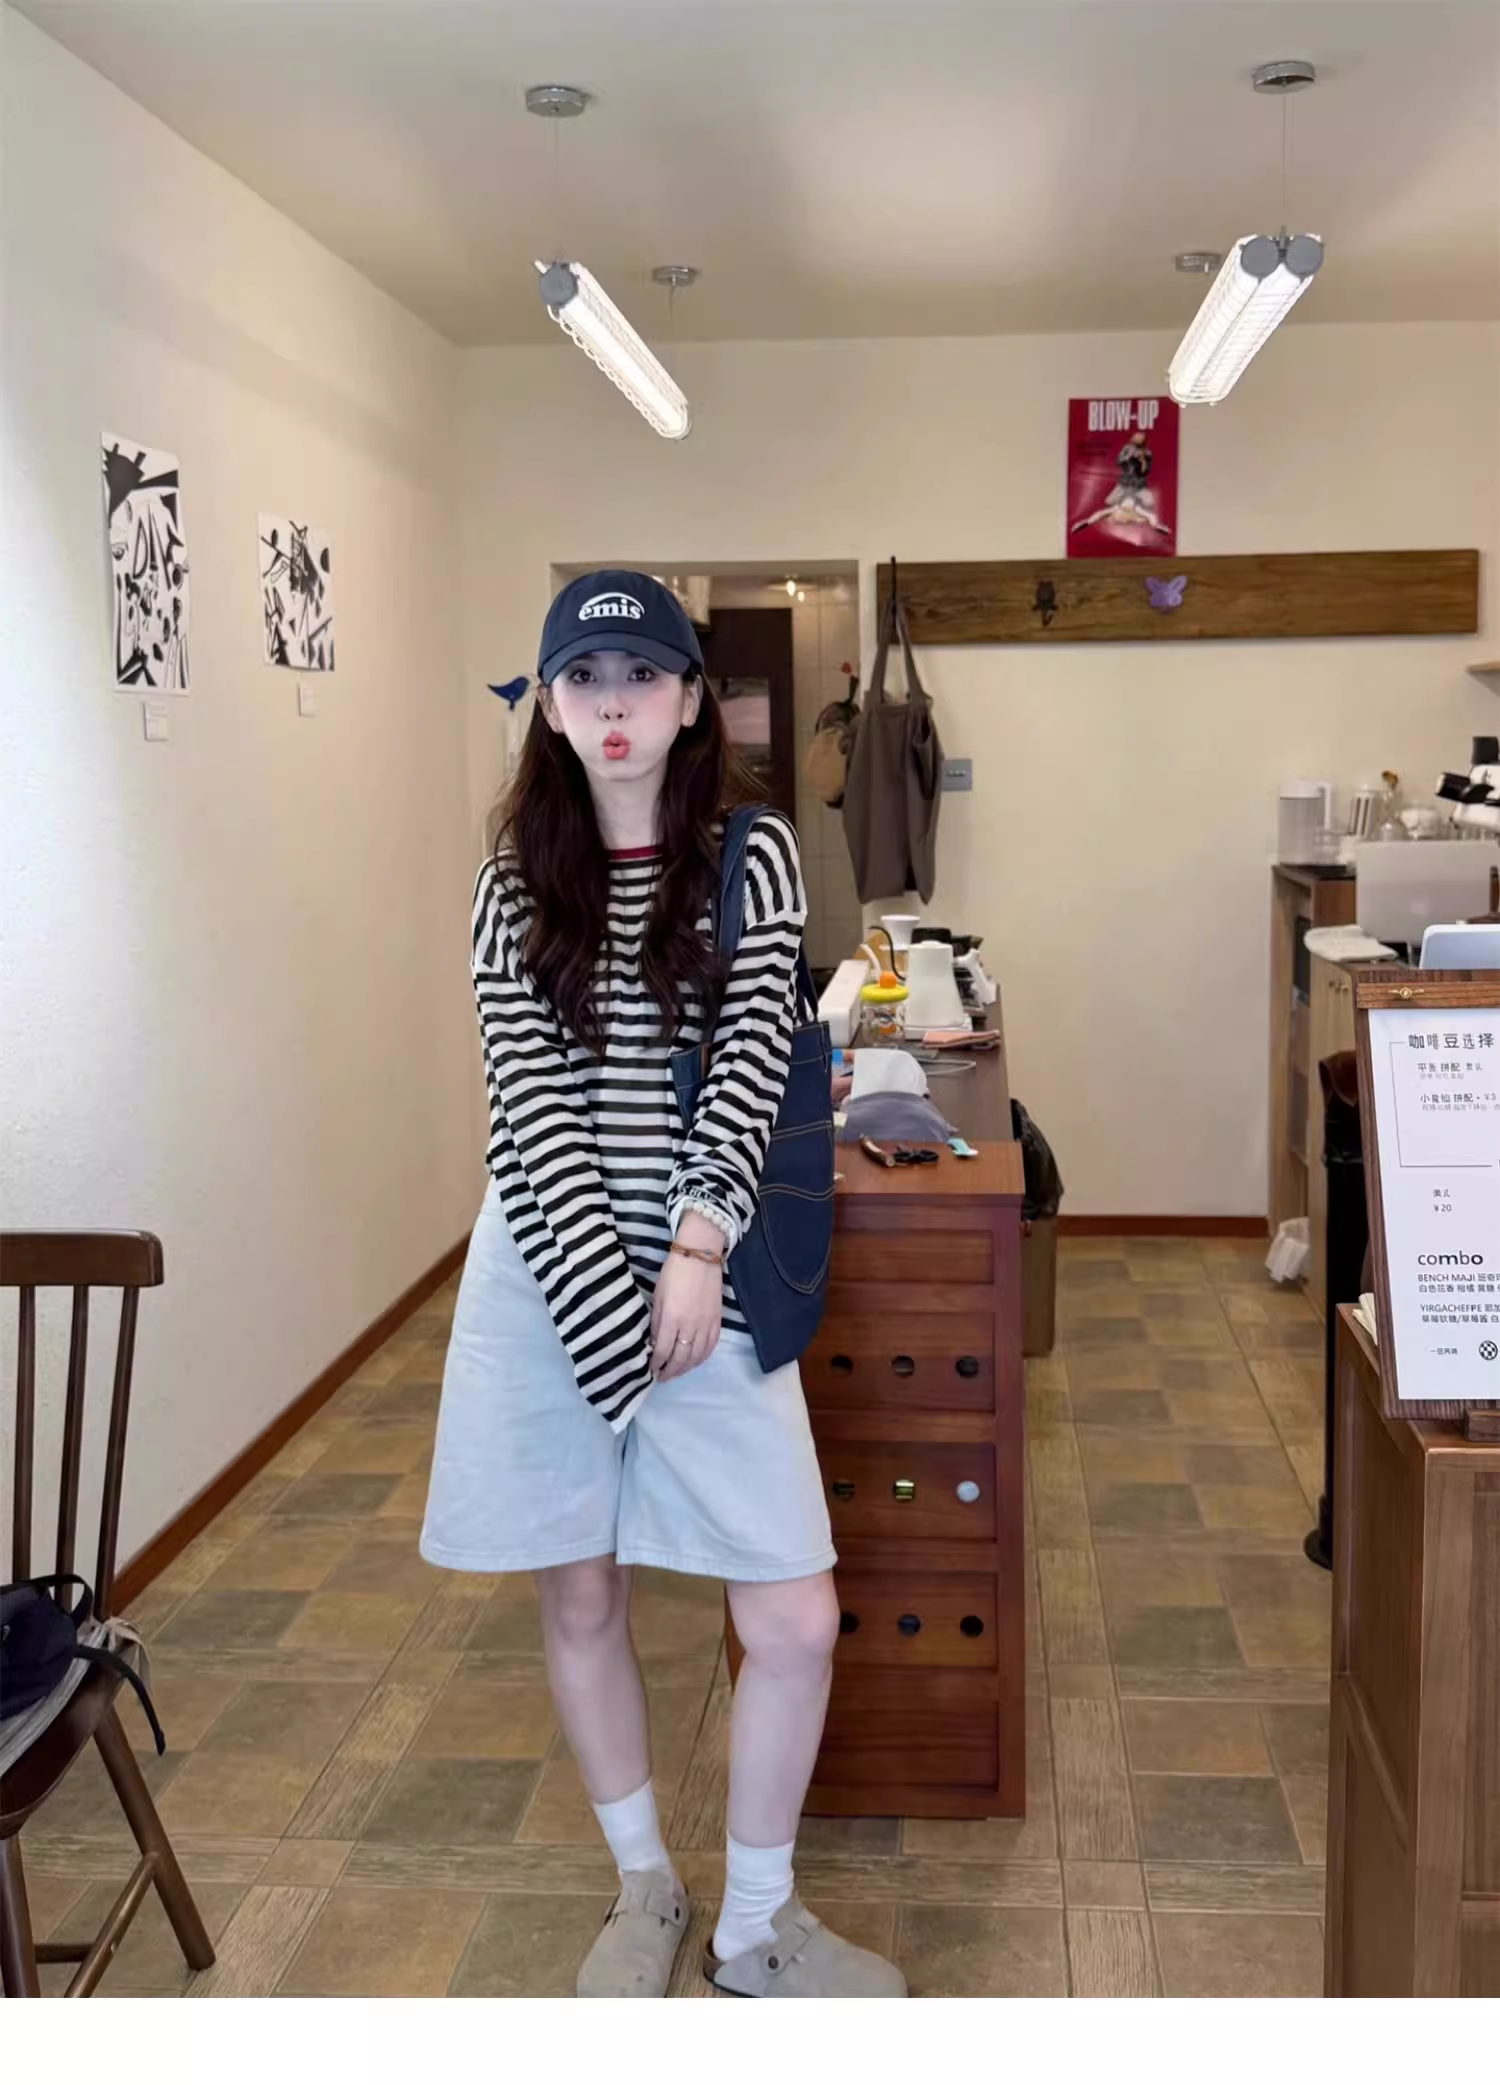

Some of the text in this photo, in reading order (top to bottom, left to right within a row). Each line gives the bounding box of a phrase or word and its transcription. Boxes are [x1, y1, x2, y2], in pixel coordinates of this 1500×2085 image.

[1088, 400, 1159, 431] BLOW-UP
[578, 598, 641, 621] emis
[1408, 1033, 1494, 1049] 咖啡豆选择
[1418, 1250, 1484, 1266] combo
[1418, 1274, 1449, 1282] BENCH
[1451, 1274, 1475, 1282] MAJI
